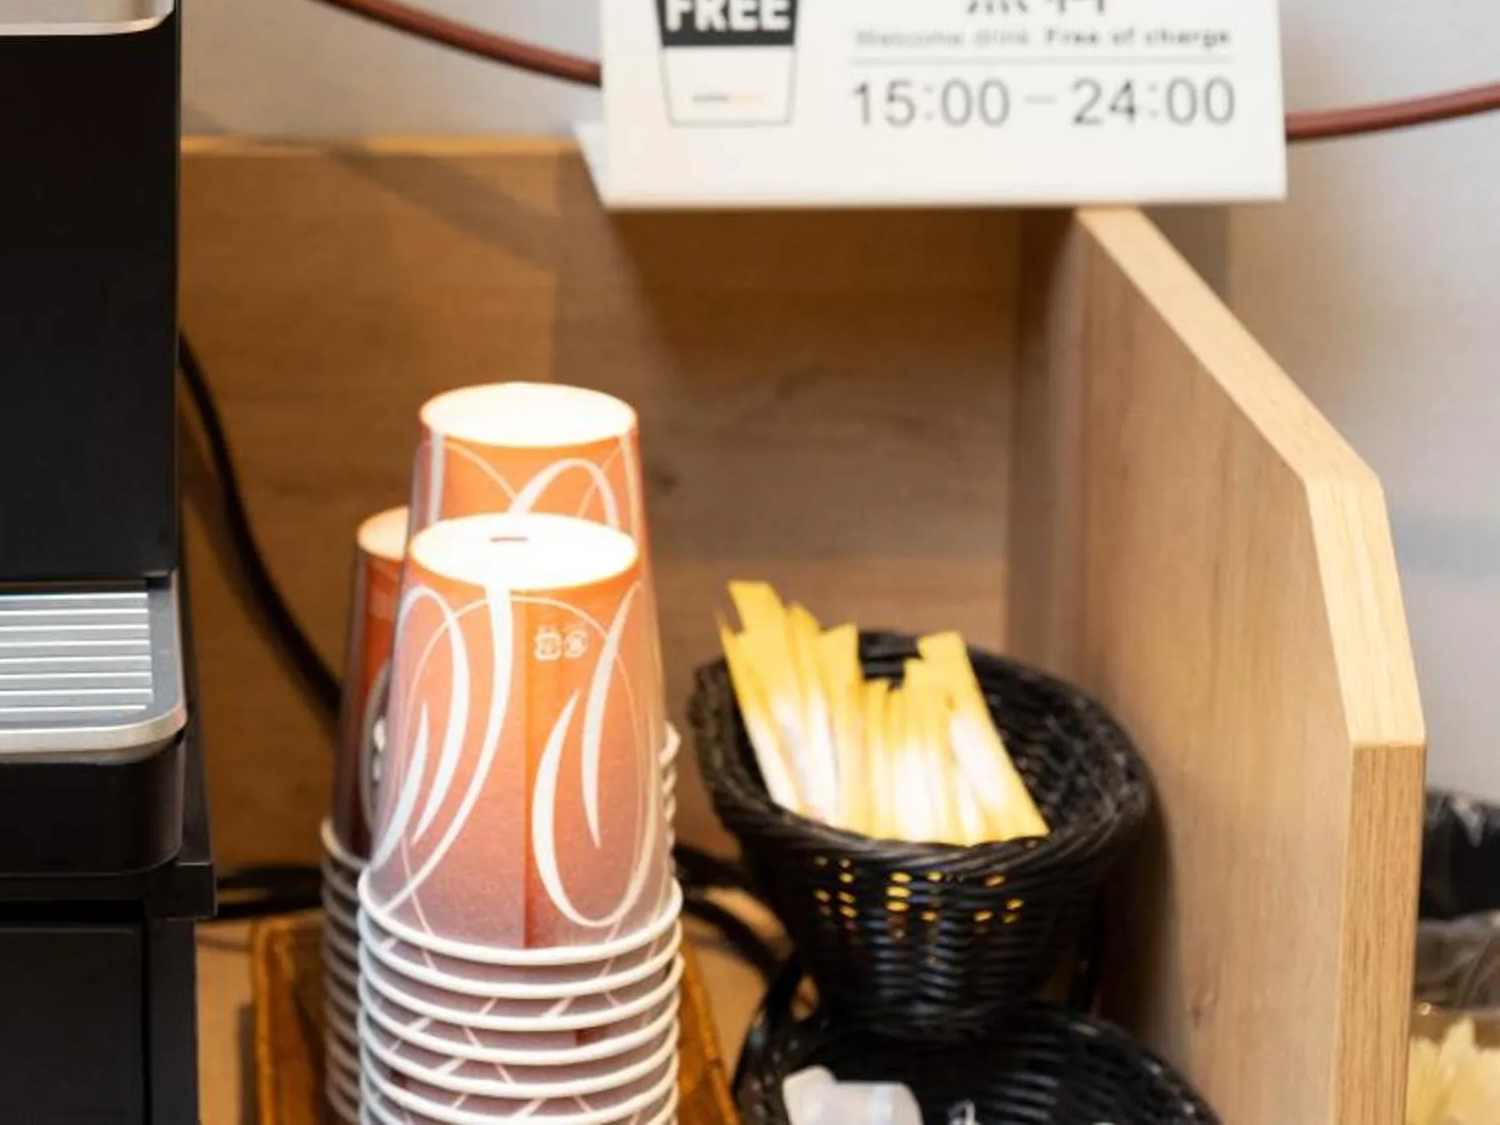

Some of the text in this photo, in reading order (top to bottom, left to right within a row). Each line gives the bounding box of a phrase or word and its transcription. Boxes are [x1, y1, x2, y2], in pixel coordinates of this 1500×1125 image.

[1045, 28, 1100, 45] Free
[853, 77, 1011, 127] 15:00
[1071, 76, 1236, 126] 24:00
